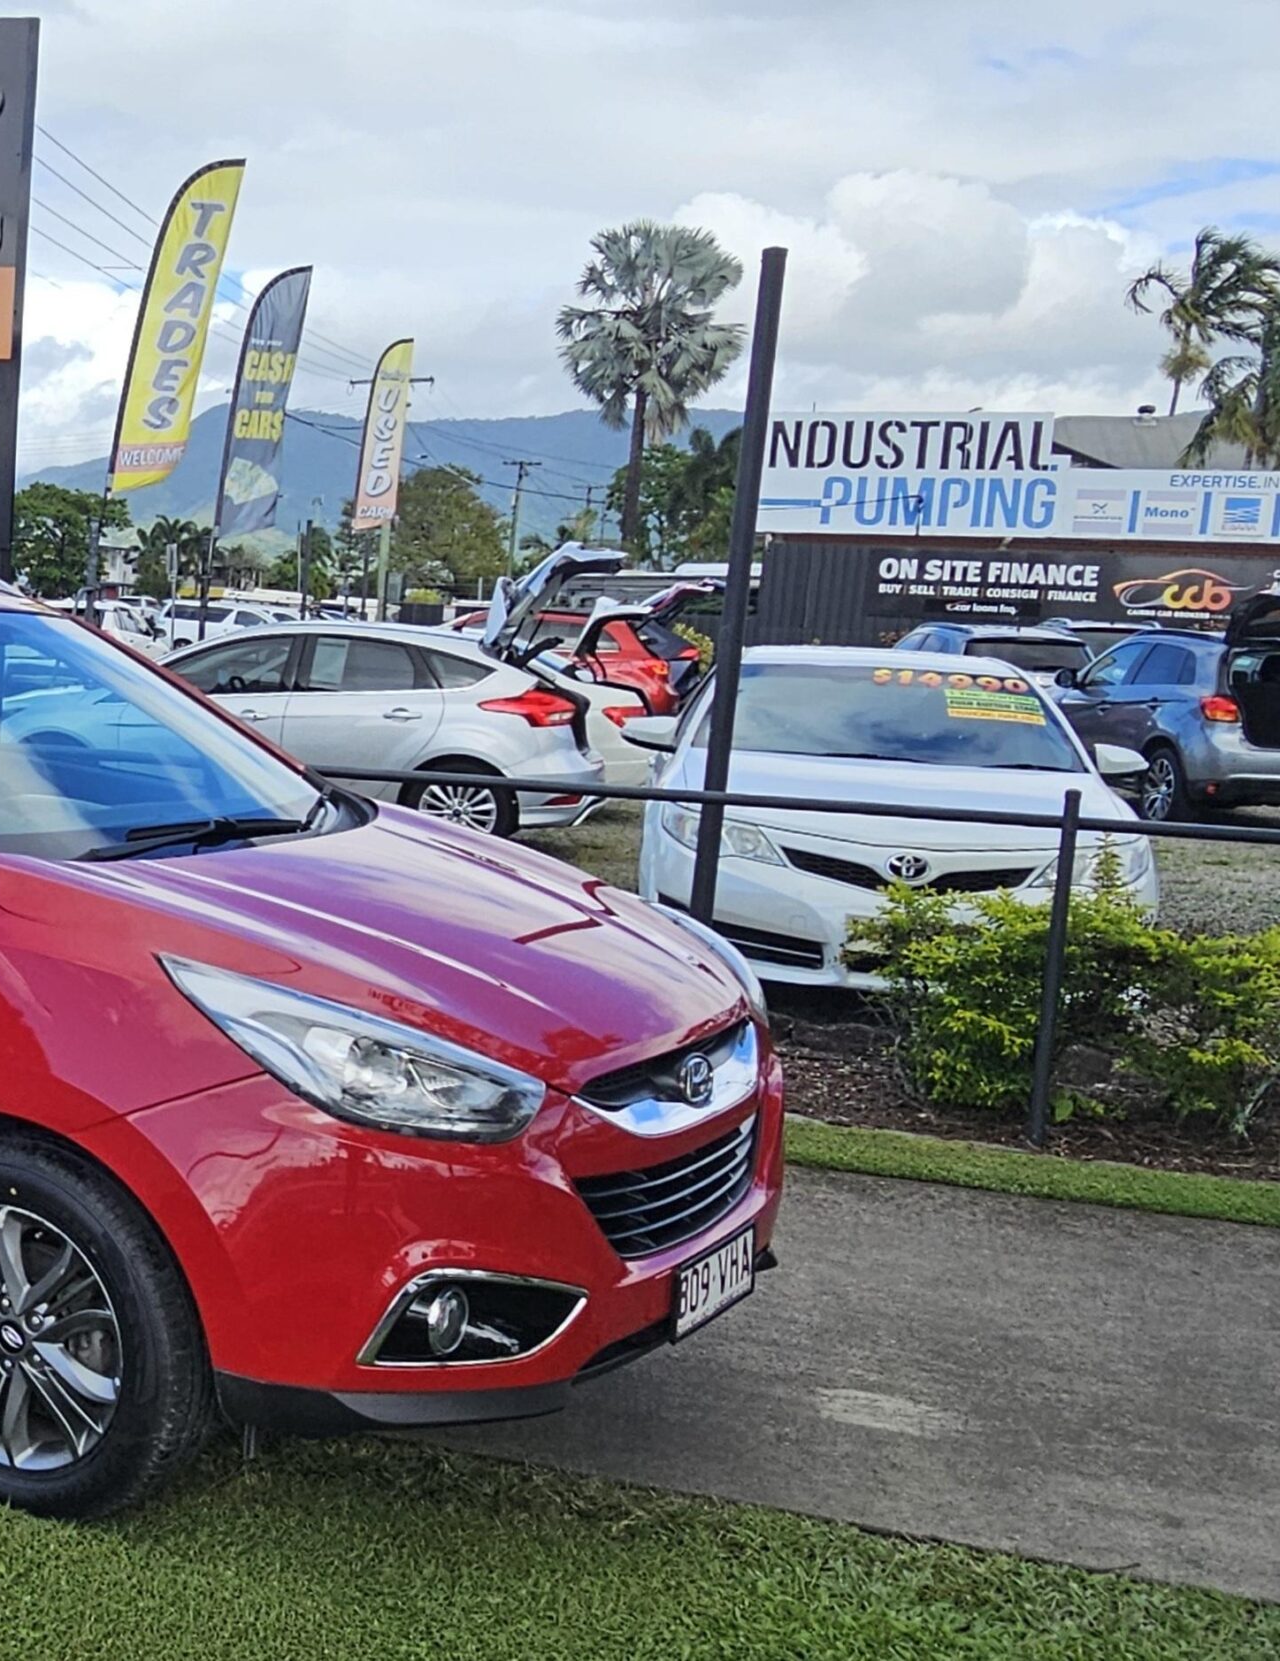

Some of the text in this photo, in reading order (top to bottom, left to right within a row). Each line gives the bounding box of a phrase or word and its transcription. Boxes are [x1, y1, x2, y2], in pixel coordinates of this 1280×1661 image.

[142, 200, 226, 431] TRADES
[365, 386, 401, 497] USED
[768, 420, 1059, 472] NDUSTRIAL.
[819, 476, 1058, 530] PUMPING
[878, 557, 1101, 587] ON SITE FINANCE
[878, 583, 1098, 602] BUY SELL TRADE CONSIGN FINANCE
[718, 1235, 750, 1295] VHA
